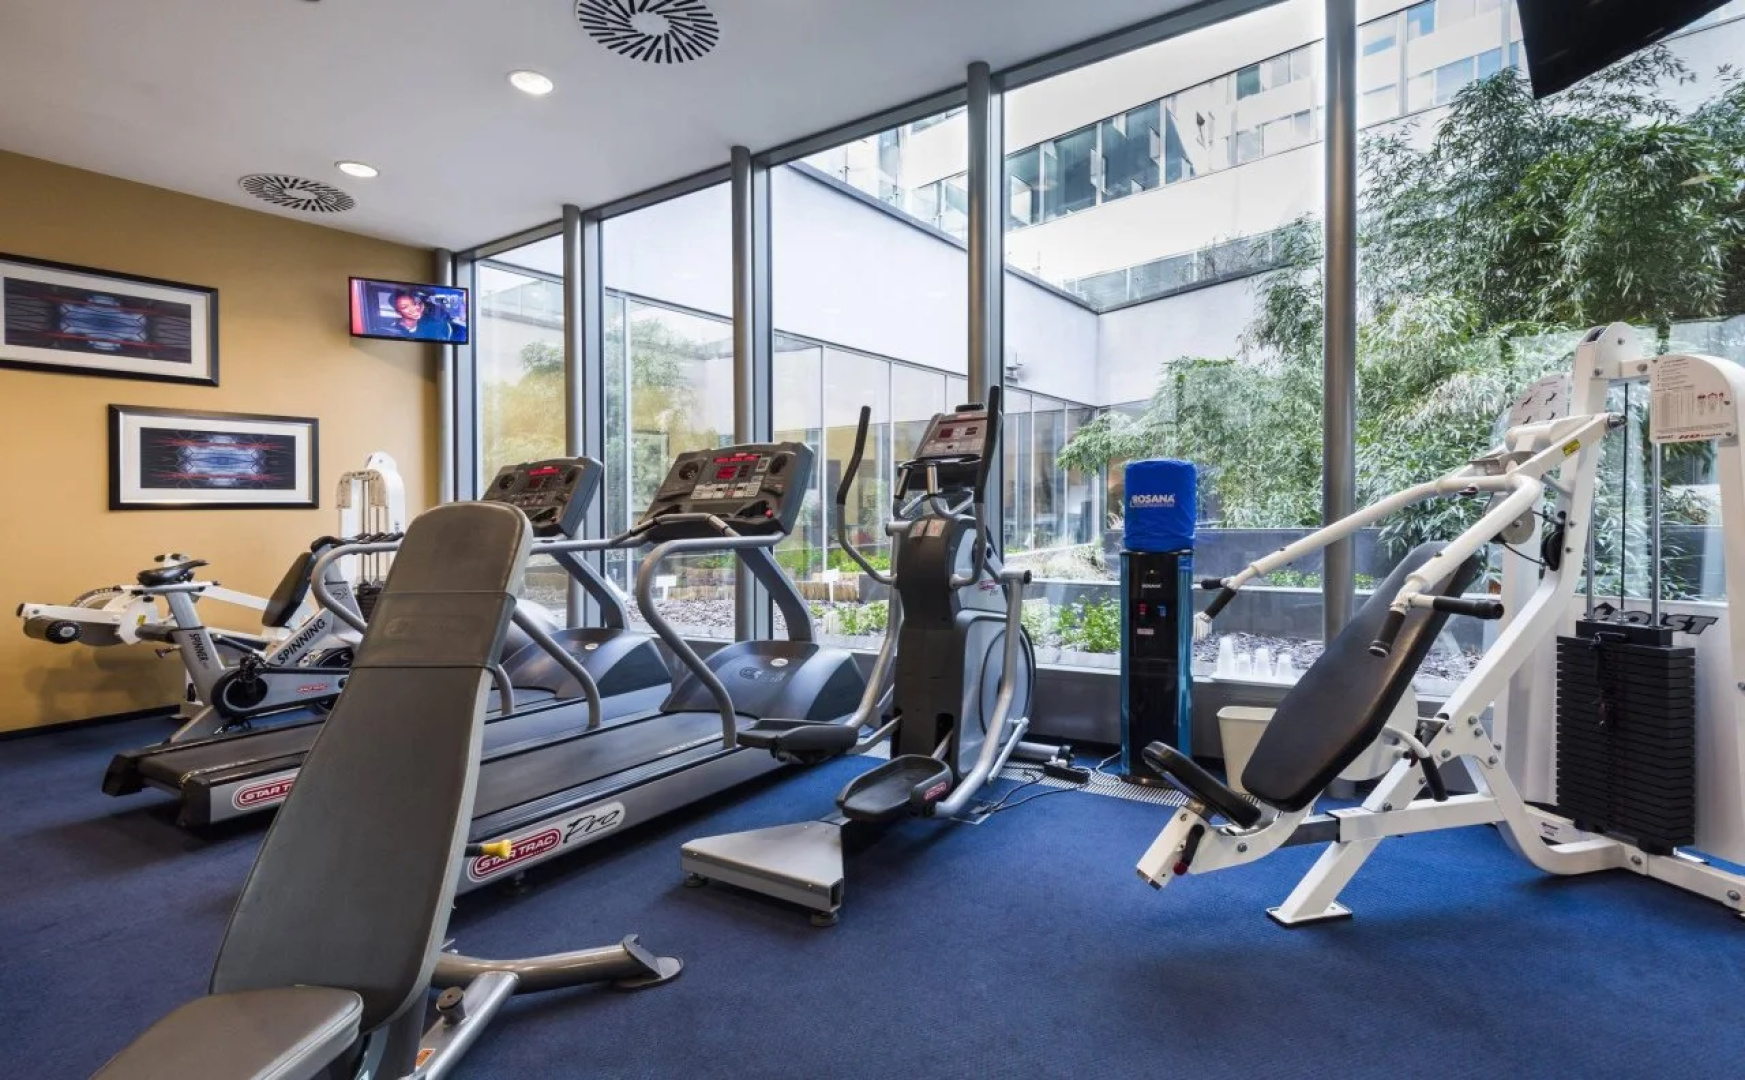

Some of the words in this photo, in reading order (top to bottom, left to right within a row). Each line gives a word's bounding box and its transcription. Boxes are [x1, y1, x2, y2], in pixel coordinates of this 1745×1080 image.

[1131, 494, 1175, 504] ROSANA
[189, 633, 209, 661] SPINNER
[277, 618, 326, 665] SPINNING
[518, 835, 556, 855] TRAC
